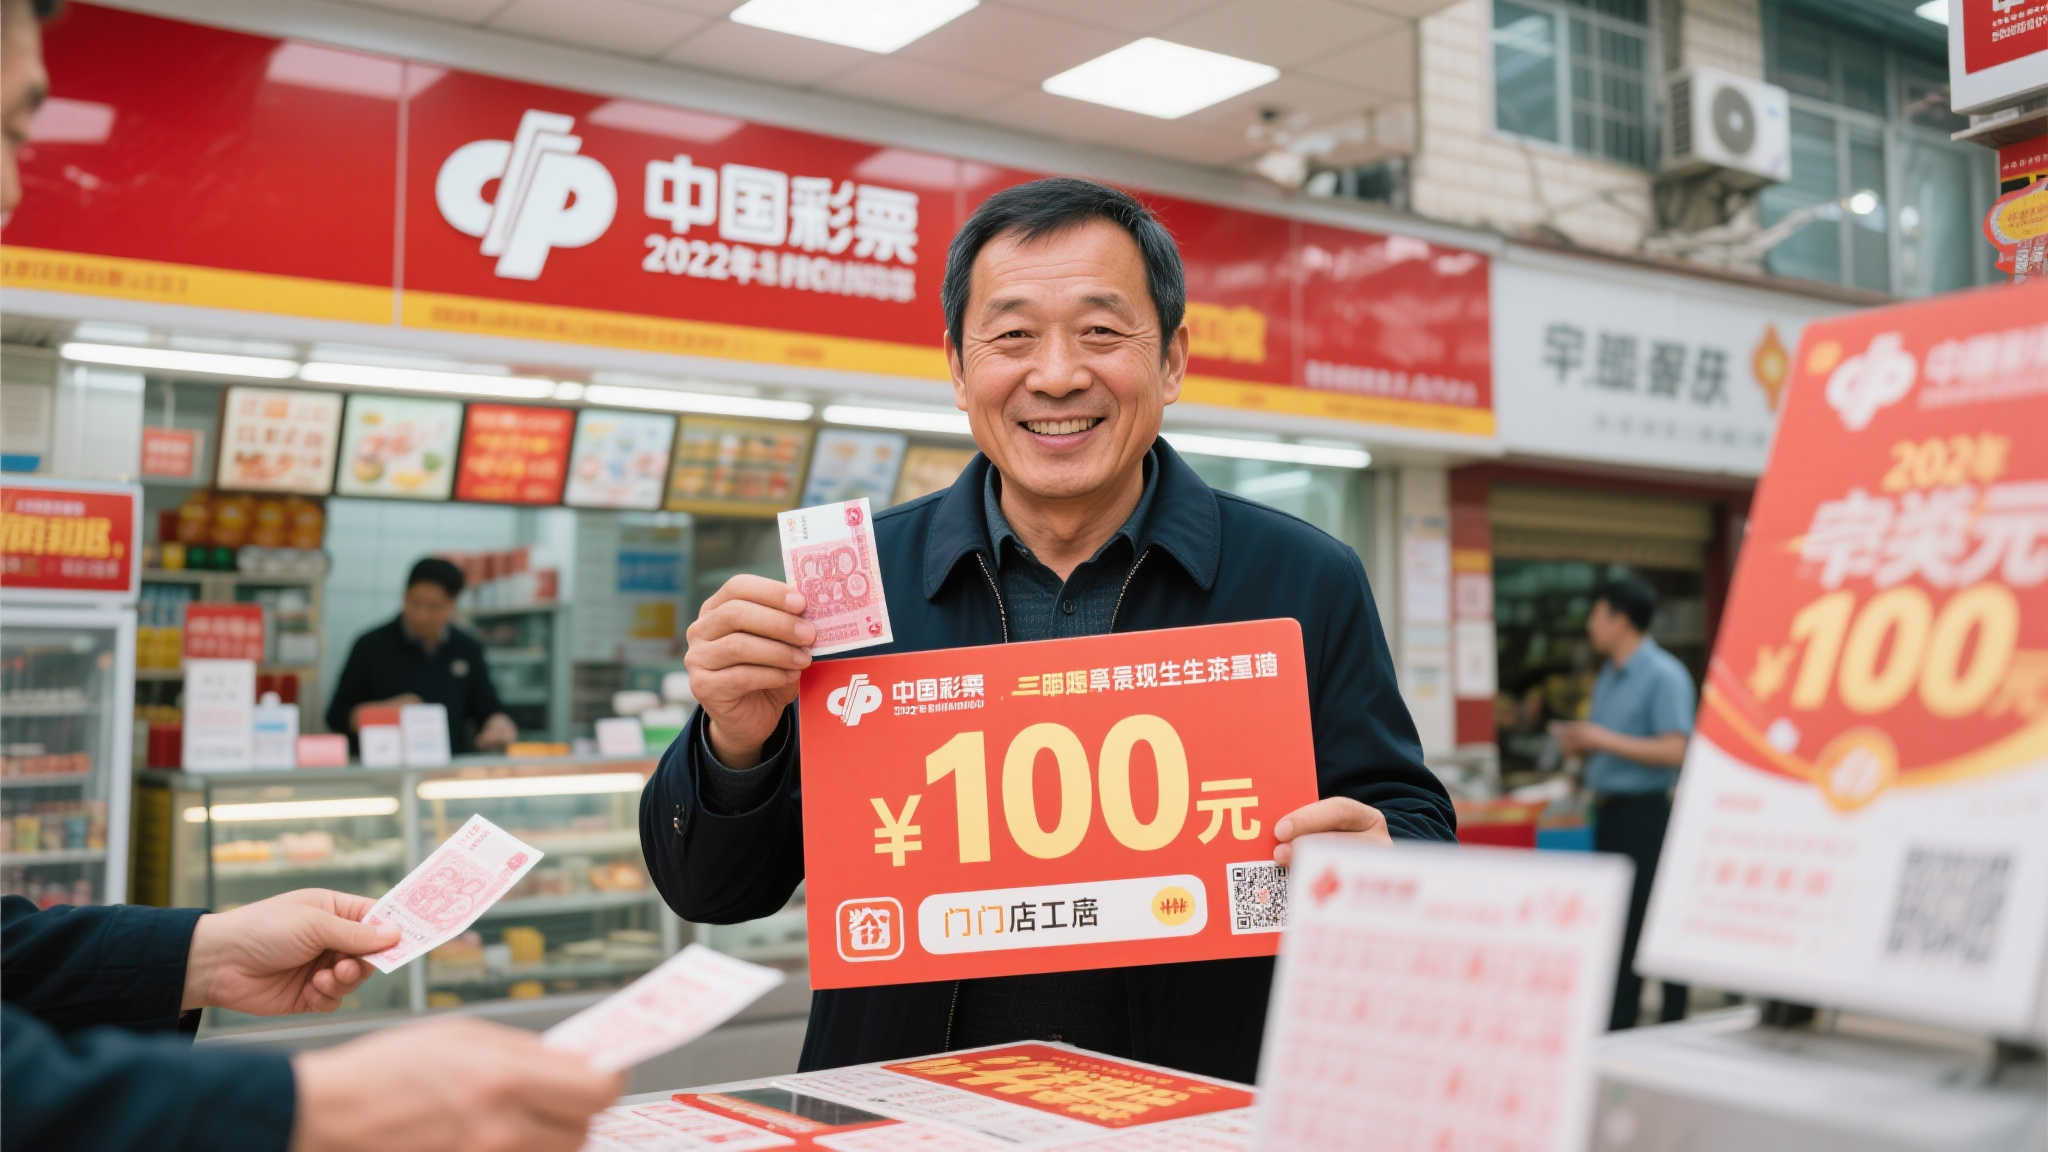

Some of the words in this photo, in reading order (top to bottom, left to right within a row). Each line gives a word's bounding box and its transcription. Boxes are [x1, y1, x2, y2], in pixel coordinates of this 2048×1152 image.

[644, 154, 919, 265] 中国彩票
[892, 674, 984, 704] 中国彩票
[870, 713, 1262, 867] ¥100元
